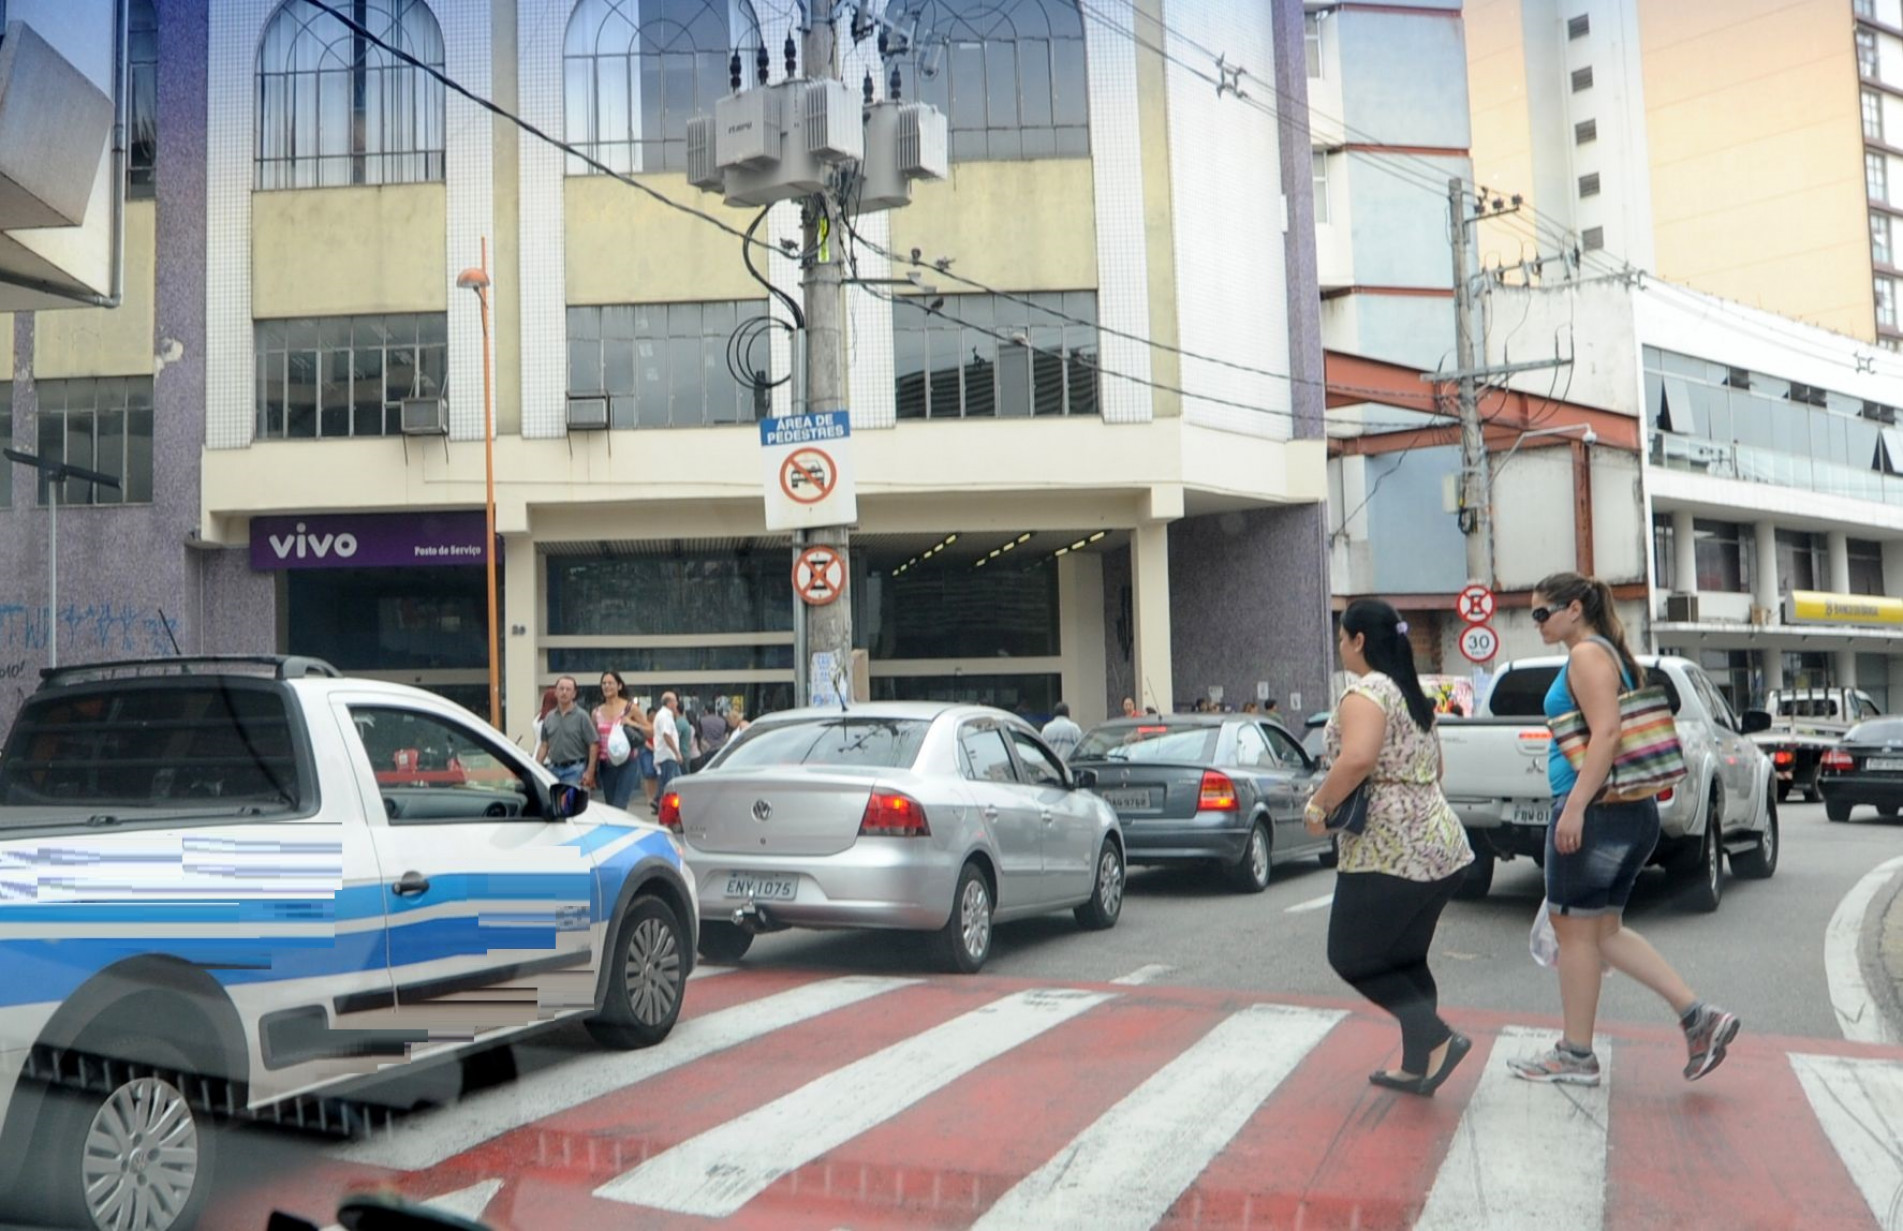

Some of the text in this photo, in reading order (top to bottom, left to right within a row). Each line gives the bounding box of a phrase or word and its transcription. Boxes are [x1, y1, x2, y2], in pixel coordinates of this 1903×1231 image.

[815, 413, 833, 427] DE
[767, 425, 844, 444] PEDESTRES
[269, 522, 358, 559] vivo
[414, 544, 481, 558] Posto de Serviço
[1468, 635, 1489, 650] 30
